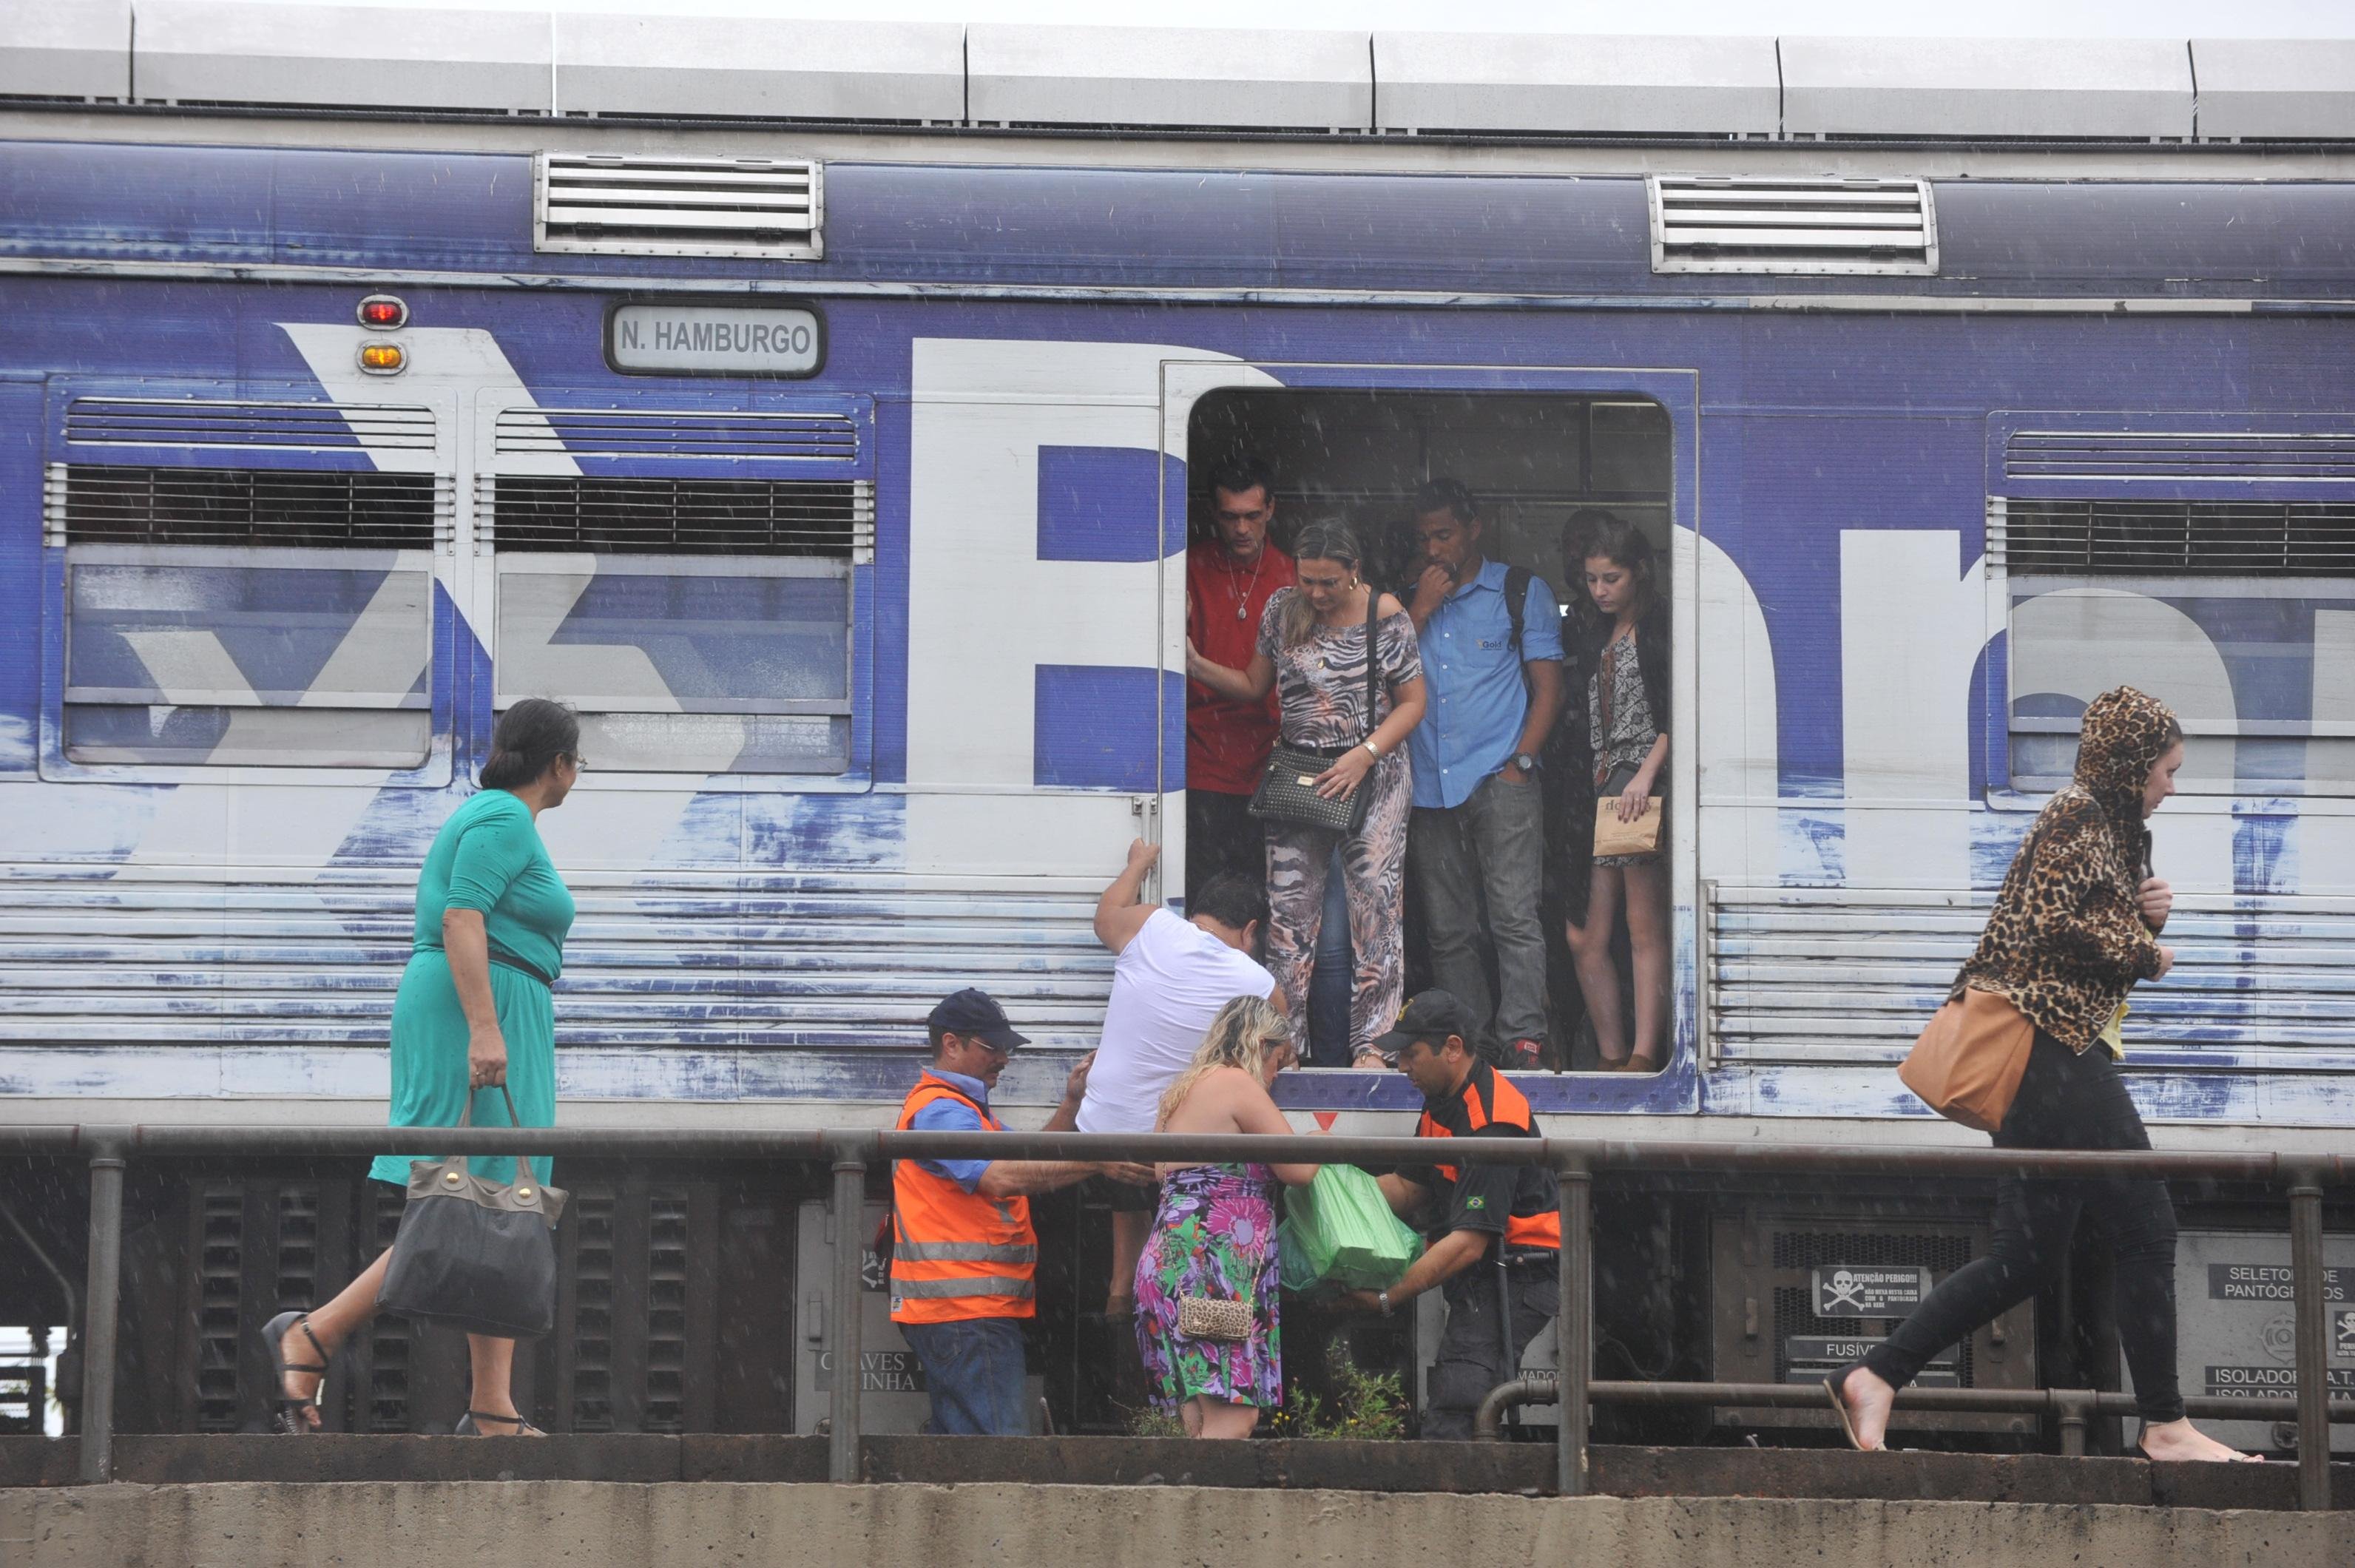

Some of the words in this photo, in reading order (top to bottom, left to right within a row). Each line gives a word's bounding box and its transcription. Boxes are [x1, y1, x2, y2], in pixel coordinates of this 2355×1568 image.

[622, 320, 645, 349] N.
[655, 322, 810, 354] HAMBURGO
[1854, 1272, 1884, 1285] ATENÇÃO
[1886, 1274, 1917, 1283] PERIGO!!!
[2229, 1267, 2294, 1281] SELETO
[1827, 1342, 1876, 1356] FUSÍV
[860, 1373, 917, 1390] INHA
